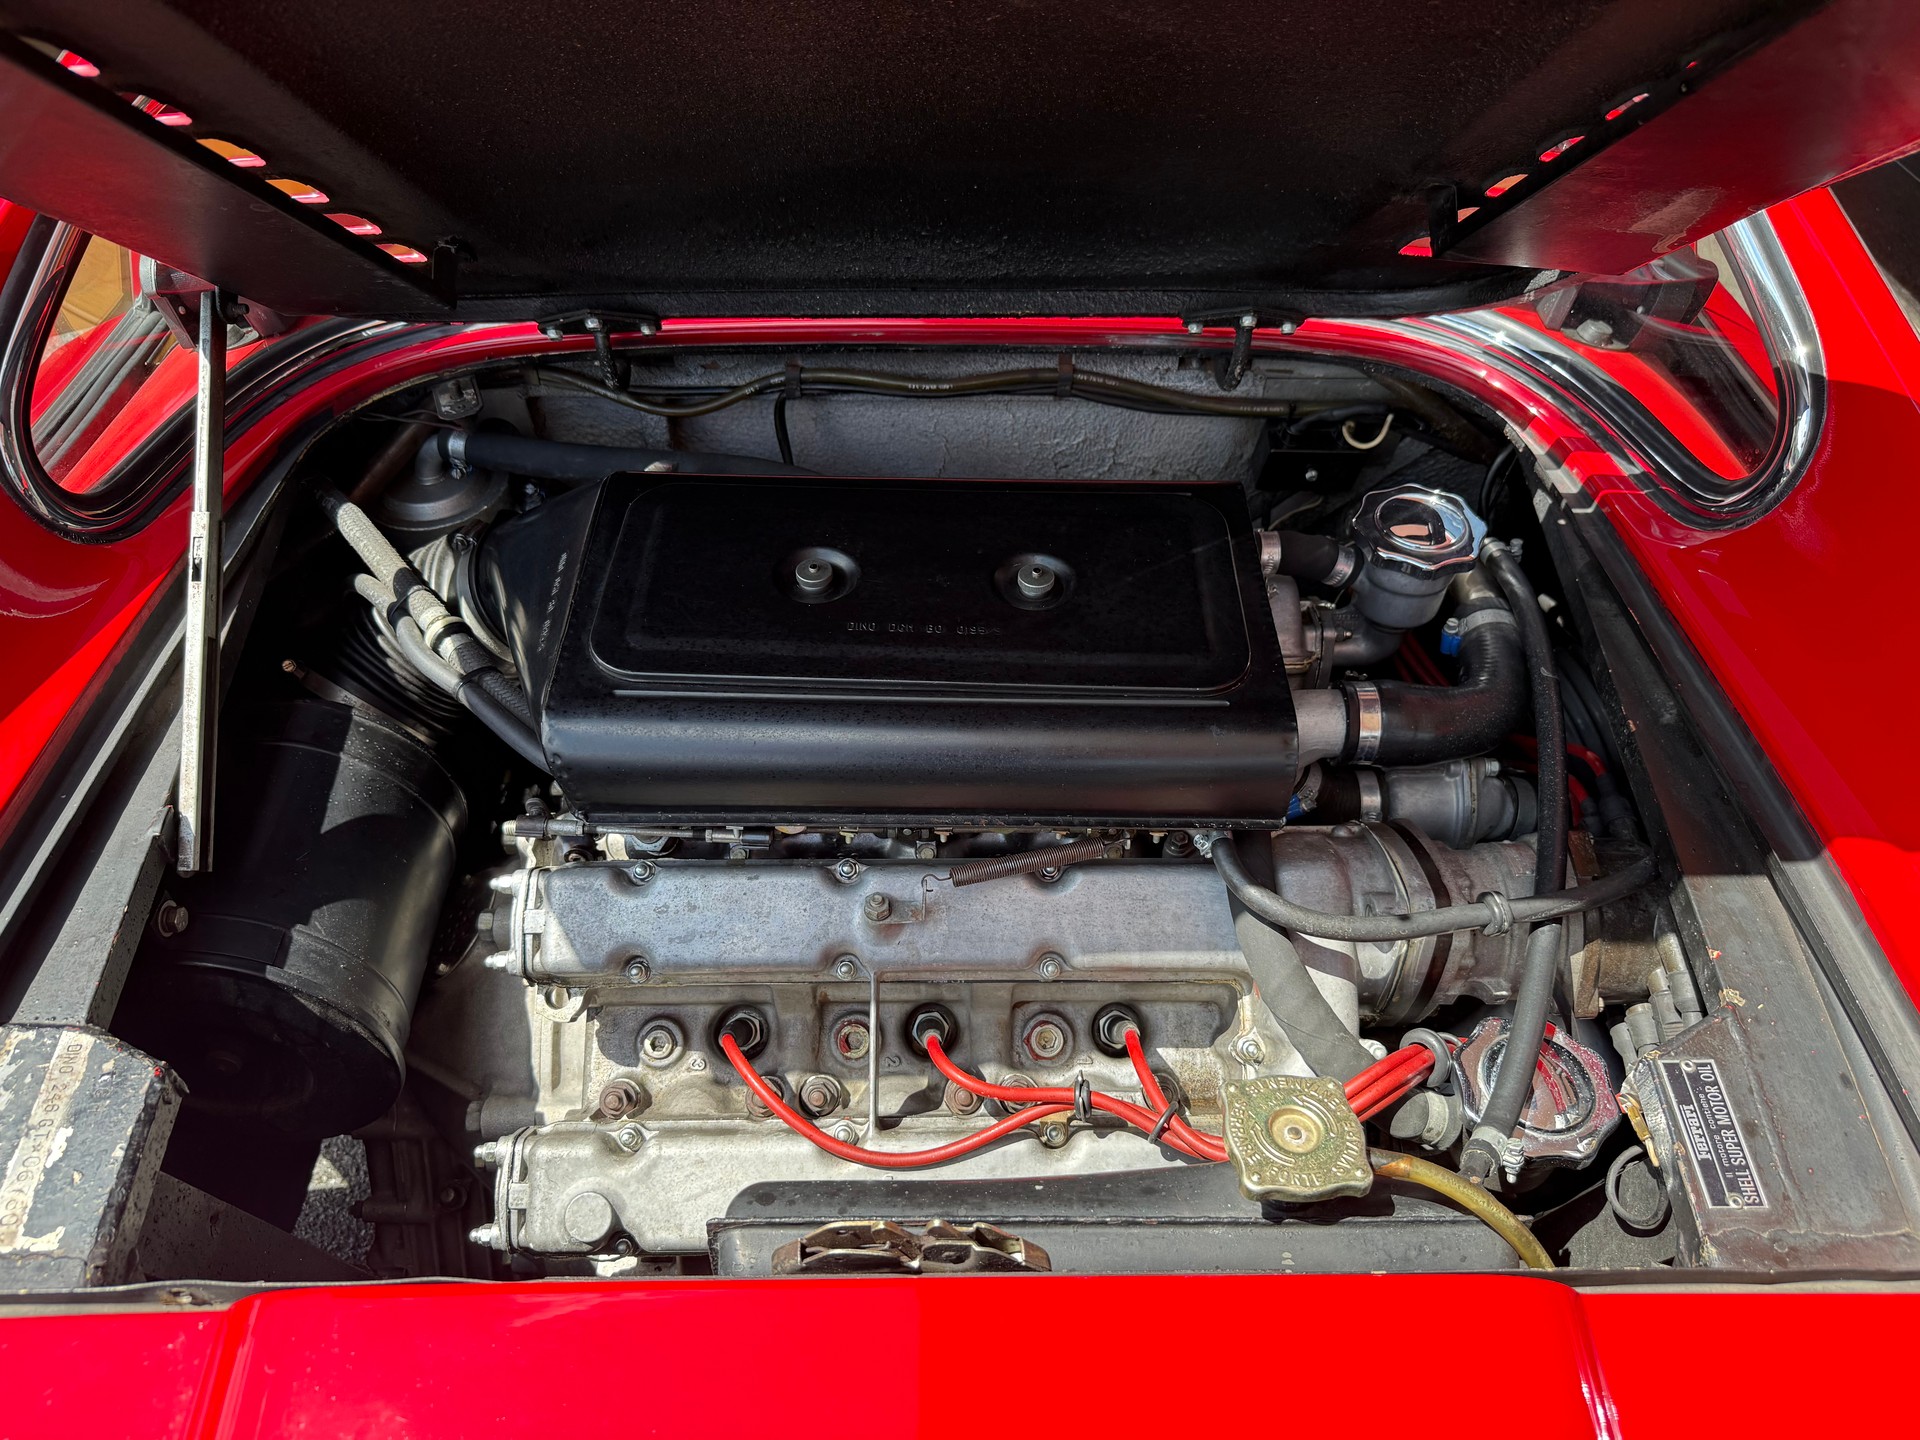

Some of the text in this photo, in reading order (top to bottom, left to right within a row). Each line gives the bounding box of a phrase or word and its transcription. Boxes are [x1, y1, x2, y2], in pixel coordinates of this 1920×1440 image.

[847, 622, 876, 631] DINO
[59, 1043, 82, 1074] DINO
[44, 1083, 67, 1112] 246
[1230, 1101, 1261, 1165] SERRARE
[1266, 1165, 1322, 1186] FORTE
[1679, 1104, 1712, 1161] Ferrari
[1697, 1064, 1760, 1204] SHELL SUPER MOTOR OIL
[1714, 1135, 1730, 1167] motore
